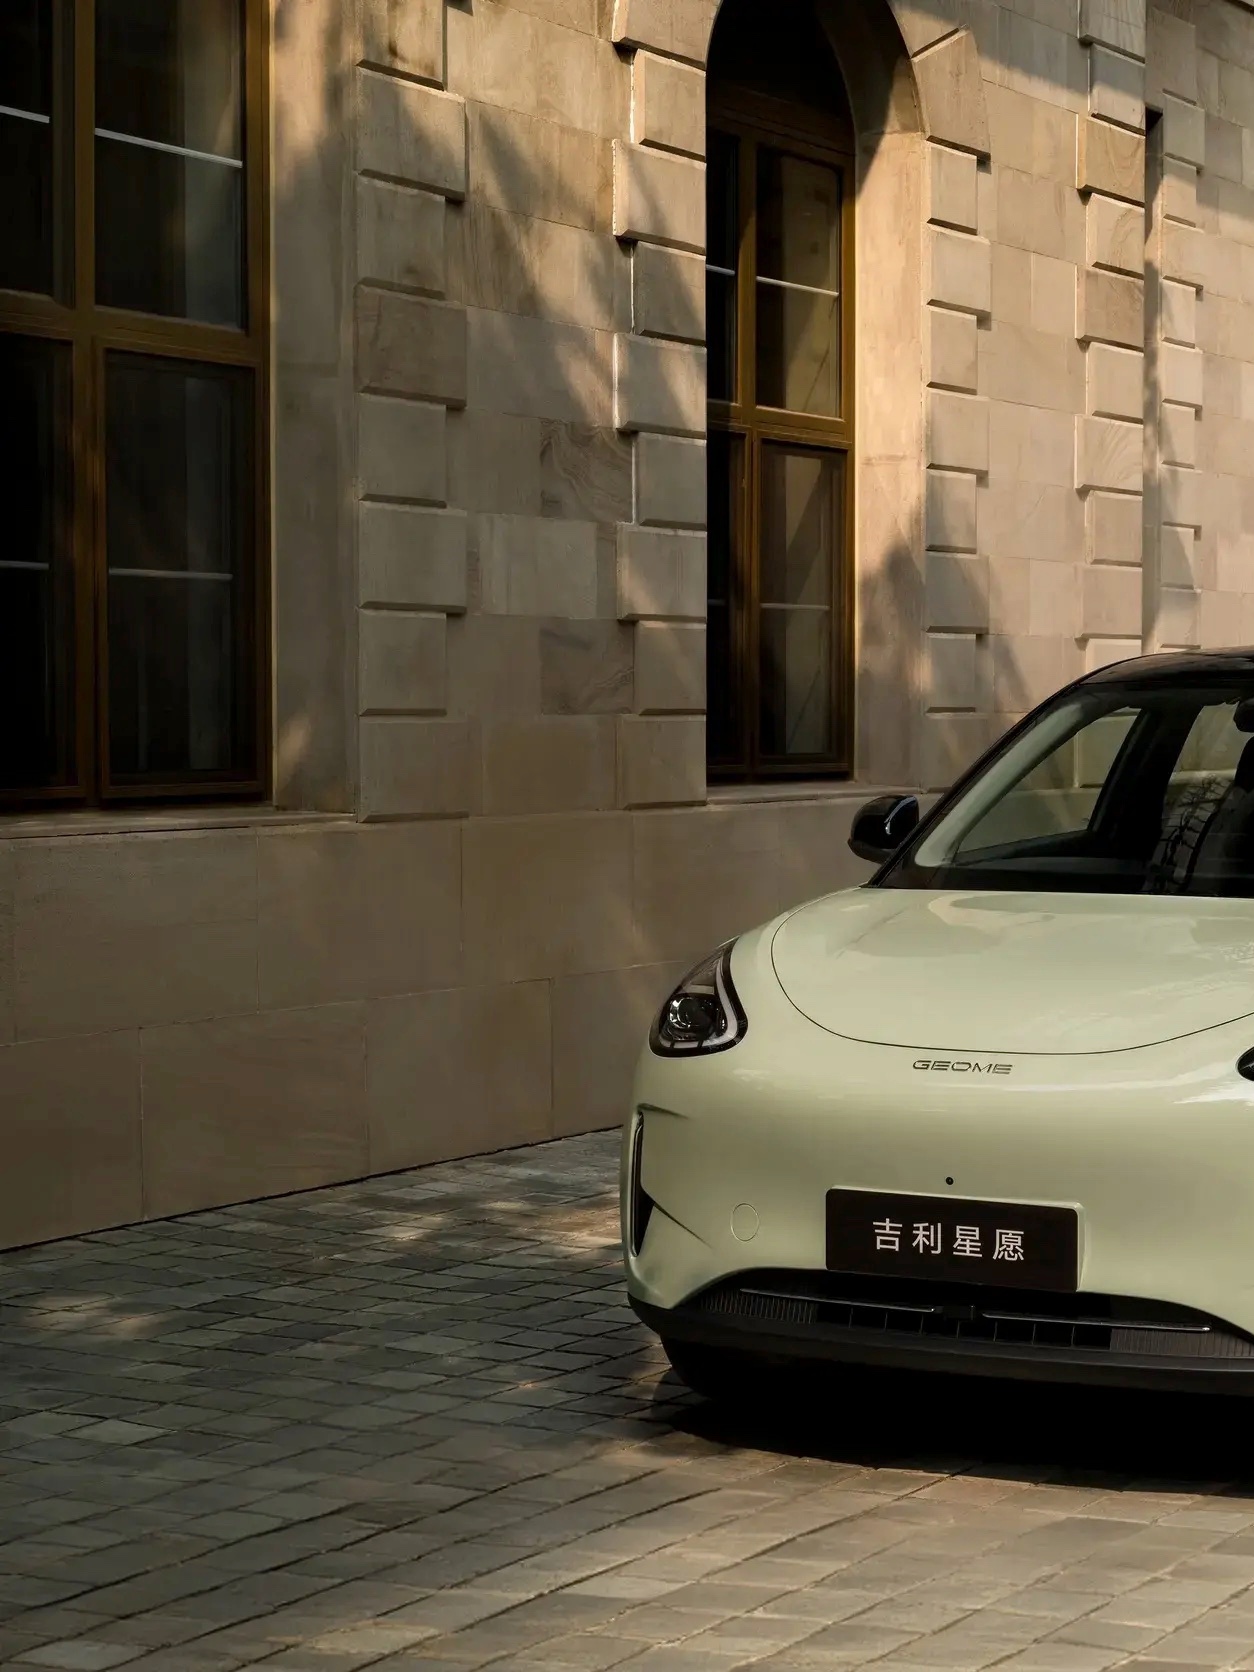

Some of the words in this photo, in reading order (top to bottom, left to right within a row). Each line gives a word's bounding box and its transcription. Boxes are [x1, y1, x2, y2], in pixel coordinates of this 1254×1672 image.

[912, 1059, 1013, 1075] GEOME
[872, 1218, 1025, 1261] 吉利星愿
